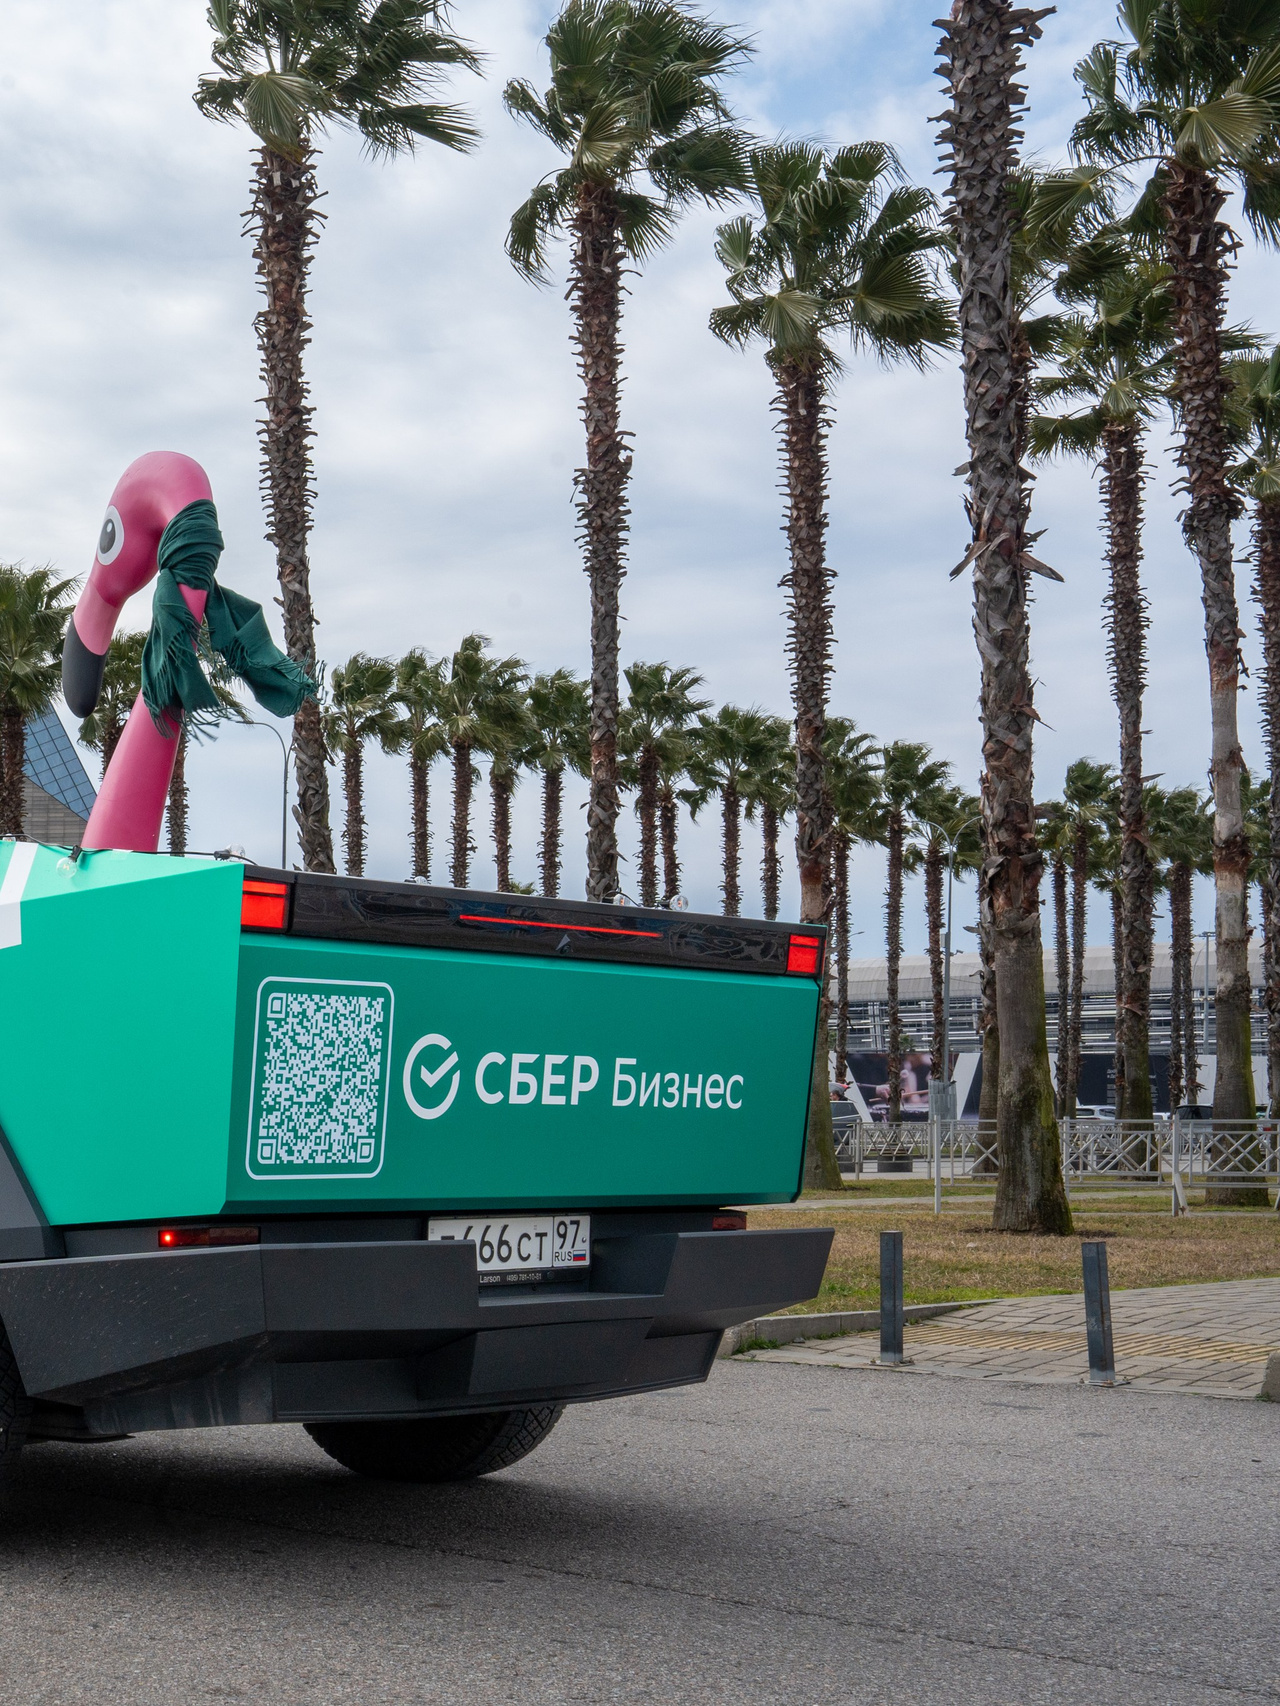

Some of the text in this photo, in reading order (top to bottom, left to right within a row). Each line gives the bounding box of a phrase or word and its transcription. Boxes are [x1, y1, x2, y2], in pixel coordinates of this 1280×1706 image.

[475, 1052, 744, 1109] СБЕР Бизнес
[556, 1220, 580, 1249] 97
[554, 1251, 572, 1262] RUS
[479, 1274, 501, 1284] Larson
